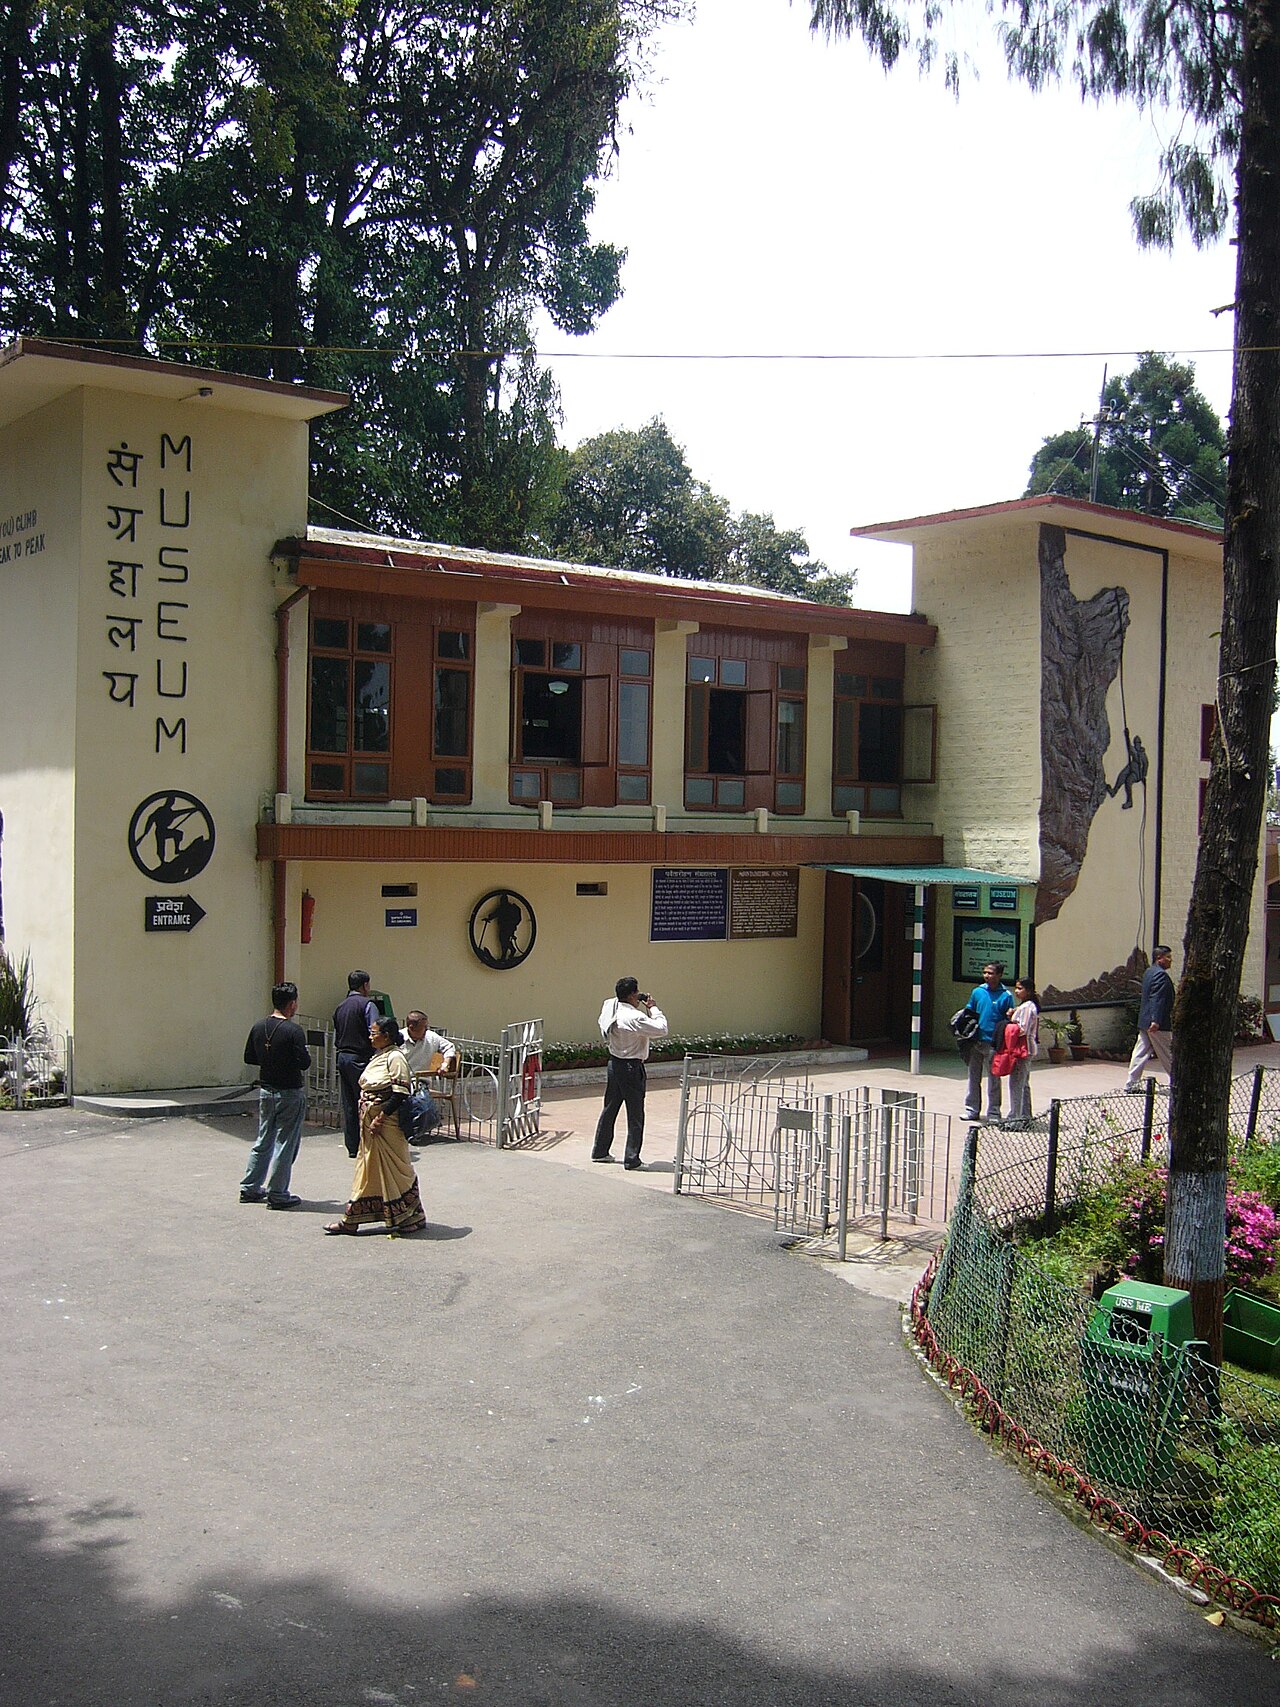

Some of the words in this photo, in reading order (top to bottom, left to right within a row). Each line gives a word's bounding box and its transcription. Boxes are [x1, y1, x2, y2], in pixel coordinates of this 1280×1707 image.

[16, 509, 37, 532] CLIMB
[14, 541, 22, 559] TO
[26, 533, 45, 556] PEAK
[102, 441, 144, 708] संग्रहालय
[156, 433, 192, 754] MUSEUM
[990, 890, 1016, 898] MUSEUM
[156, 899, 184, 913] प्रवेश
[153, 914, 191, 926] ENTRANCE
